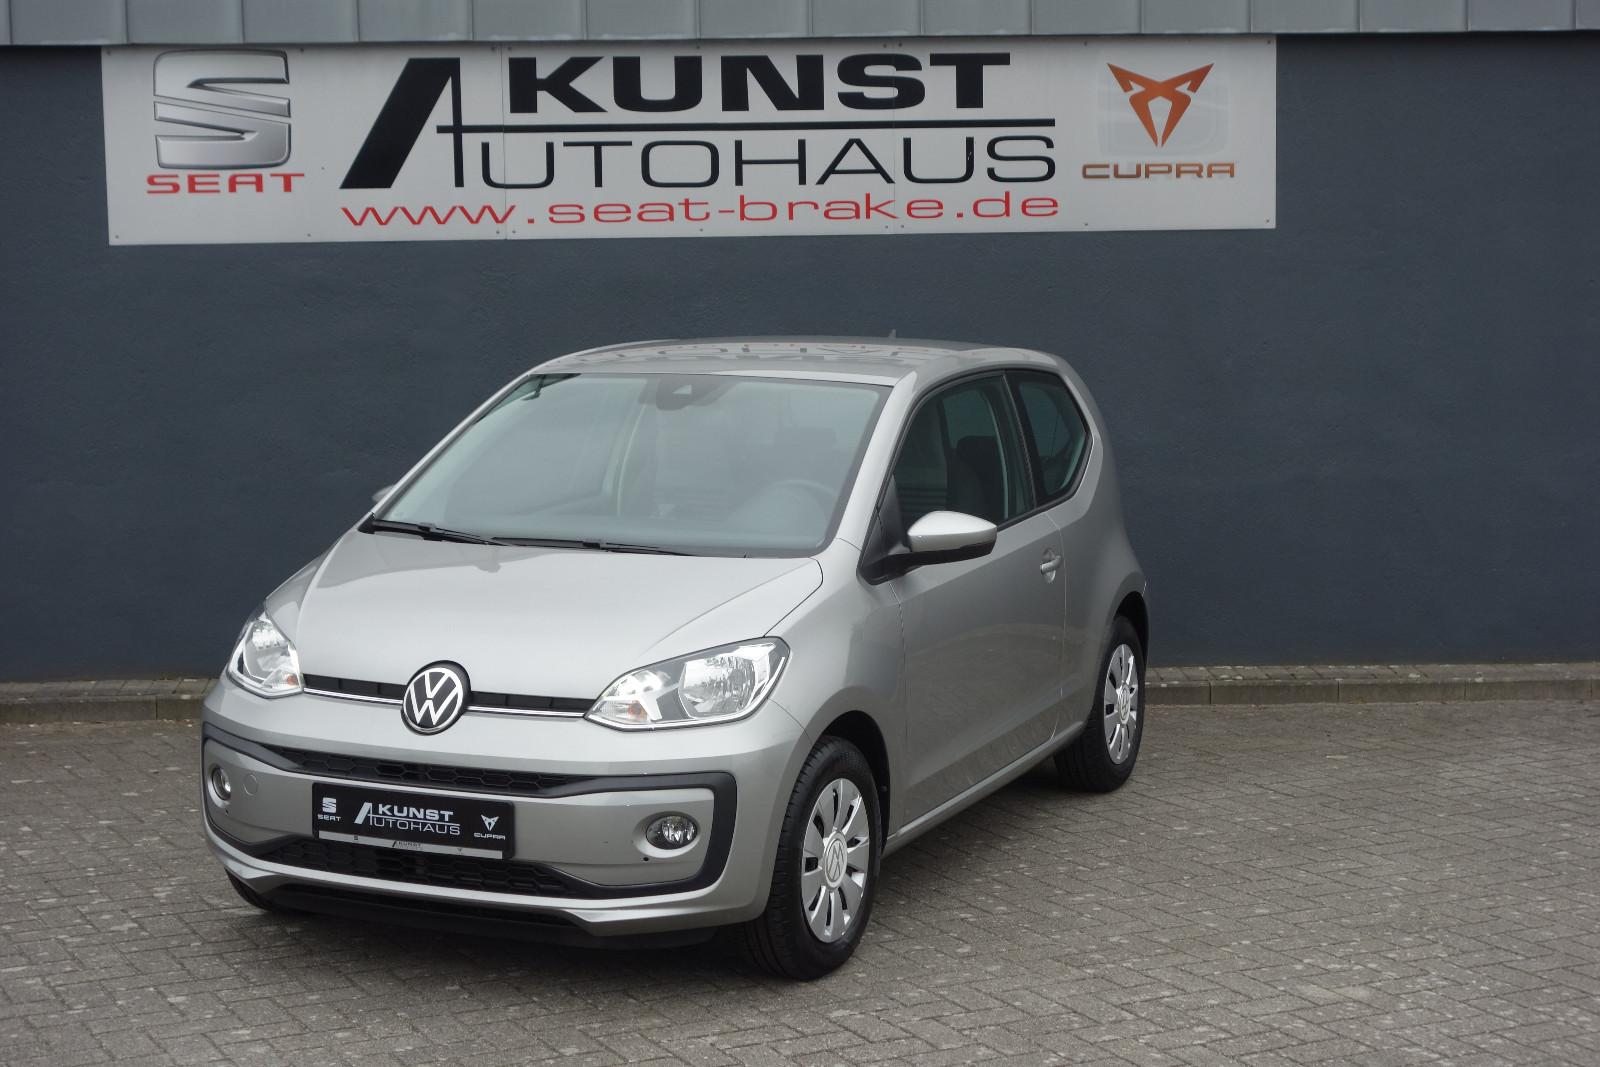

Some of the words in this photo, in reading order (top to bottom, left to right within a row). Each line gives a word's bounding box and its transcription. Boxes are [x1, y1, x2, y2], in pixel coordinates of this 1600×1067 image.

[508, 52, 1011, 114] KUNST
[1082, 162, 1235, 180] CUPRA
[146, 173, 305, 195] SEAT
[341, 190, 1059, 227] www.seat-brake.de
[317, 813, 342, 823] SEAT
[378, 803, 454, 822] KUNST
